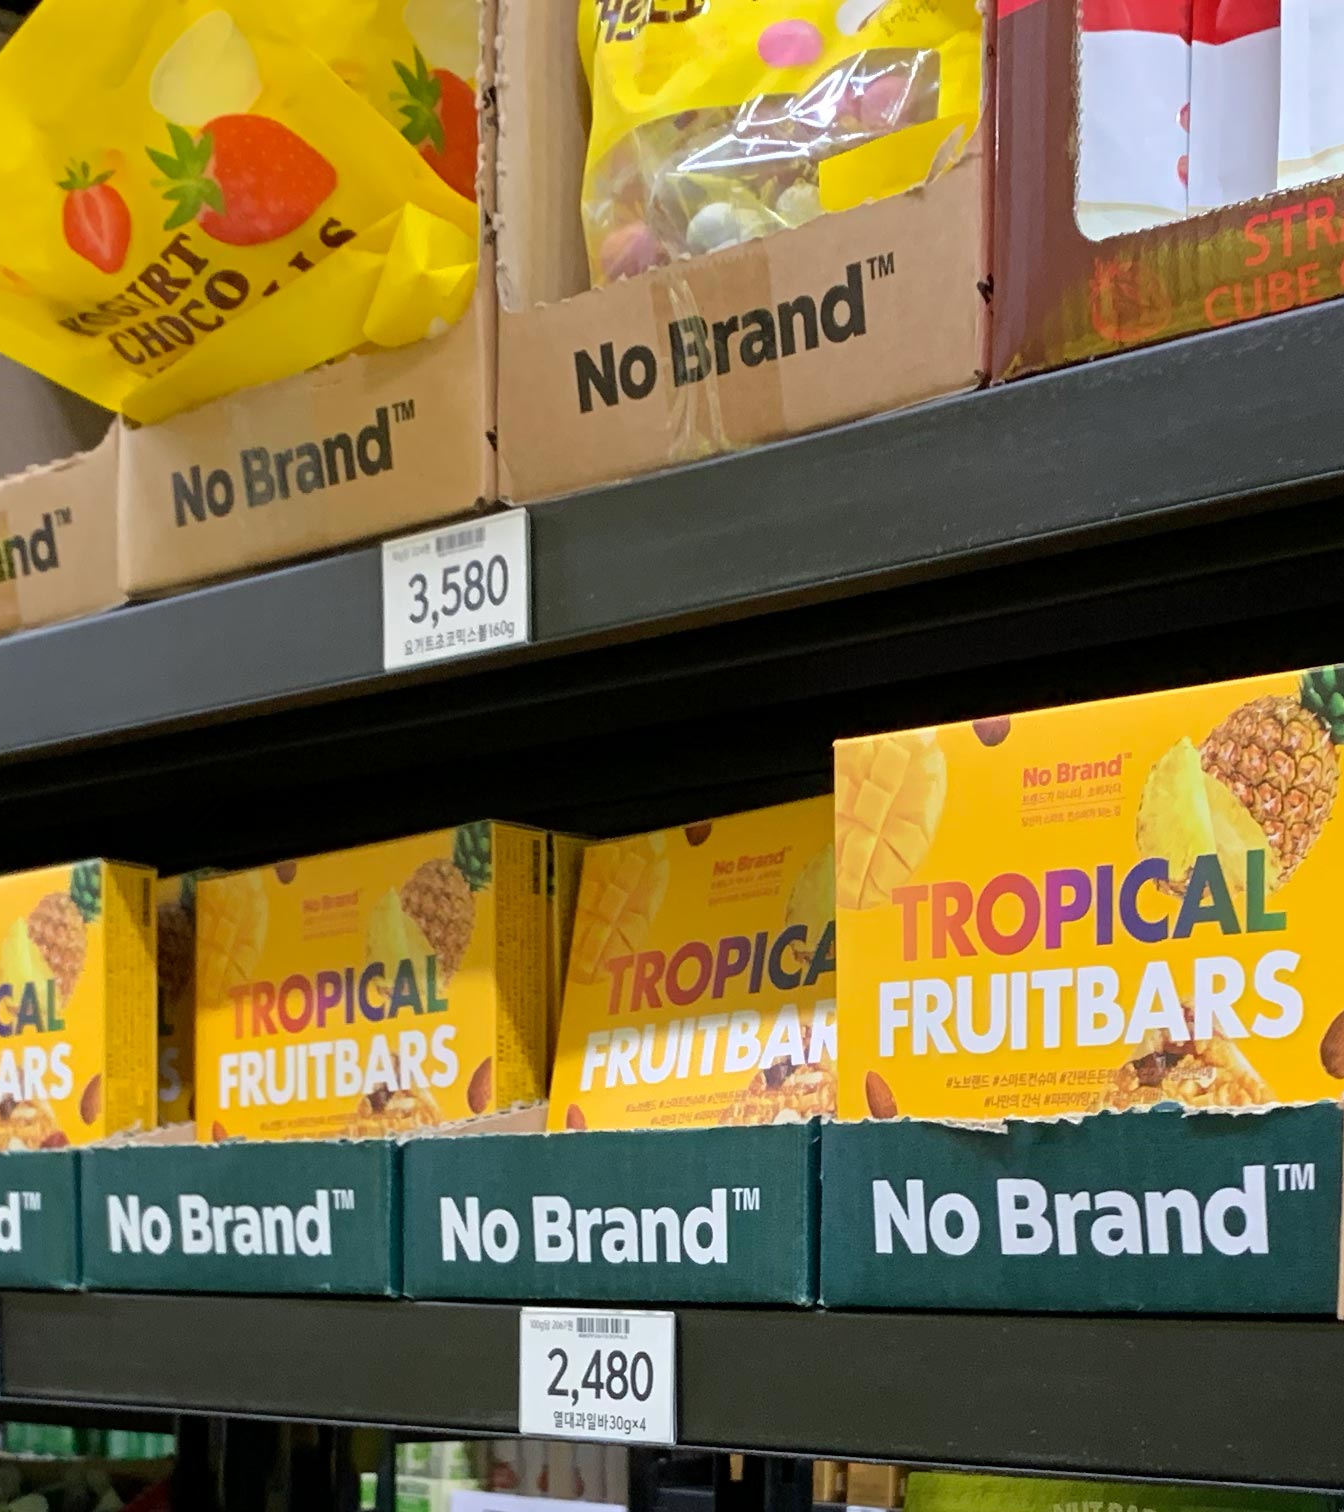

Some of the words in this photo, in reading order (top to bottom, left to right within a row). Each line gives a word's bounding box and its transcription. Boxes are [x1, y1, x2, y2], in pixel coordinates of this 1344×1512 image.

[1205, 259, 1320, 328] CUBE
[575, 342, 656, 413] No
[172, 459, 234, 527] No
[408, 554, 509, 629] 3,580
[1023, 767, 1051, 788] No
[892, 849, 1288, 961] TROPICAL
[230, 954, 450, 1040] TROPICAL
[877, 949, 1304, 1058] FRUITBARS
[218, 1025, 458, 1110] FRUITBARS
[107, 1194, 172, 1255] No
[440, 1196, 519, 1265] No
[872, 1178, 981, 1256] No
[547, 1348, 654, 1406] 2,480
